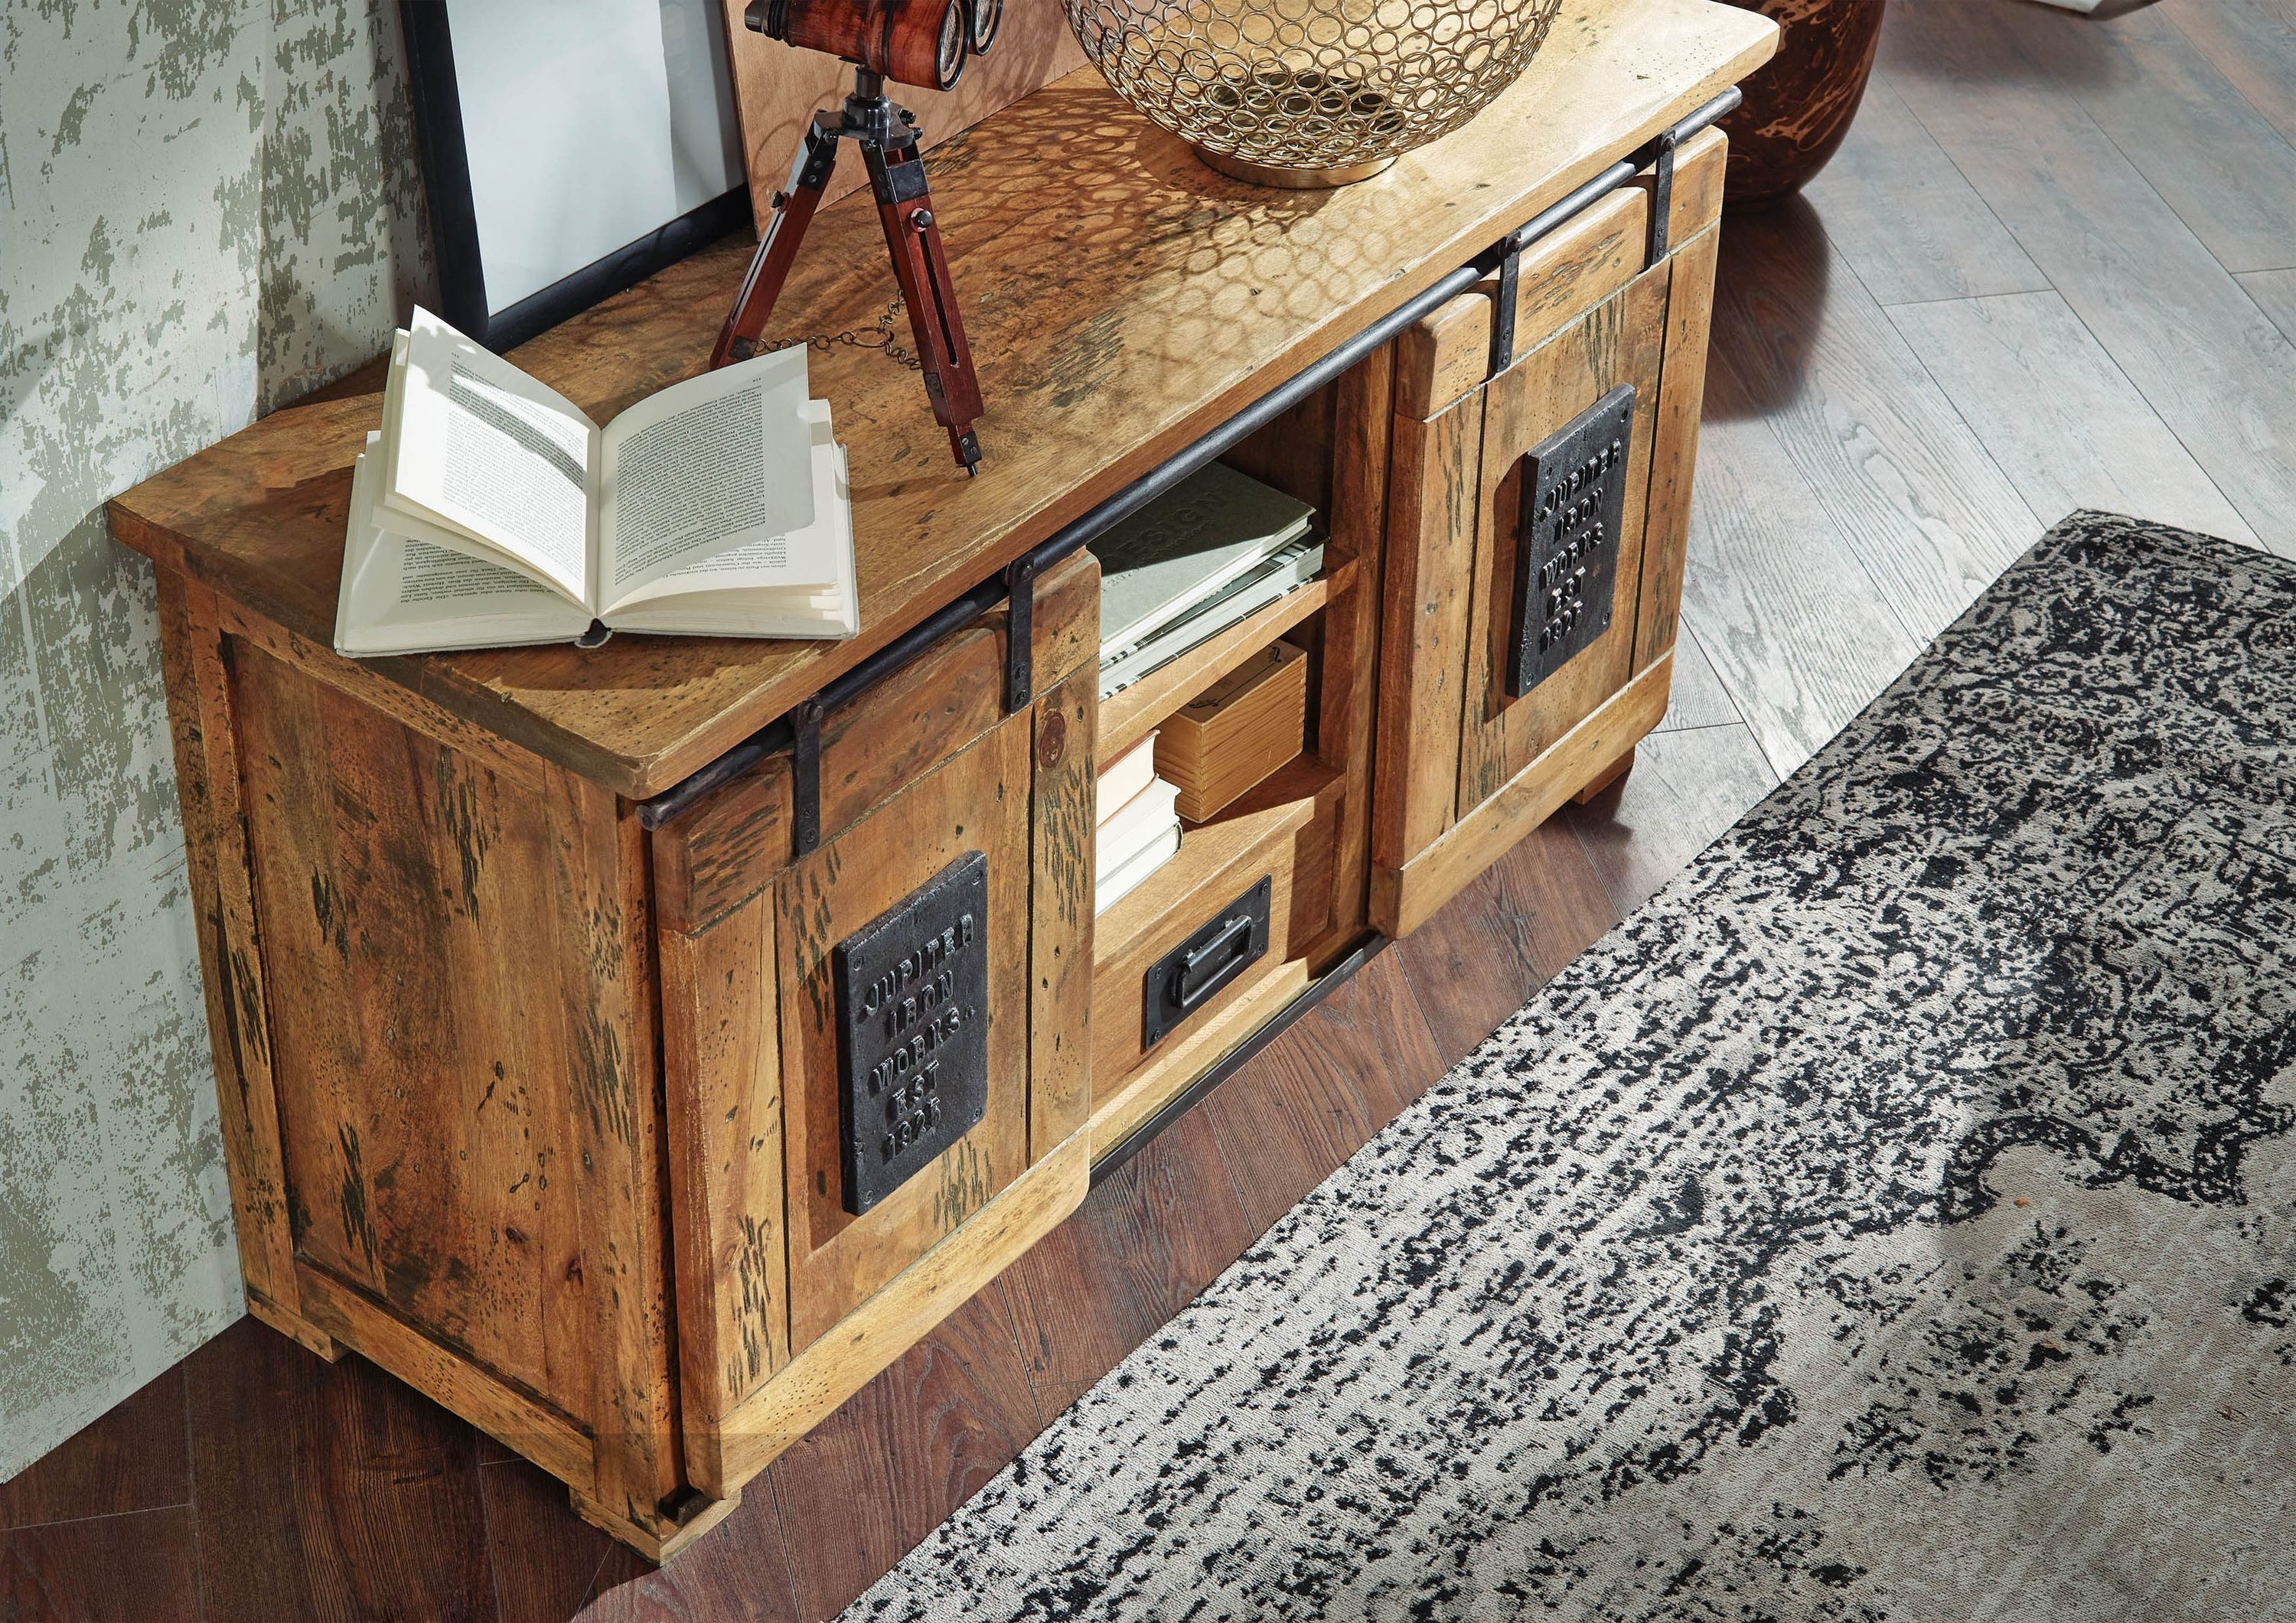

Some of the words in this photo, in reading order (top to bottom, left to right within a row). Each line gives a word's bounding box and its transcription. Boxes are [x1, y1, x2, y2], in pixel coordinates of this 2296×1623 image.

[1543, 438, 1621, 518] JUPITER
[1560, 487, 1604, 541] IRON
[1542, 522, 1604, 588] WORKS
[1551, 566, 1586, 614] EST
[864, 914, 974, 1016] JUPITER
[889, 970, 954, 1038] IRON
